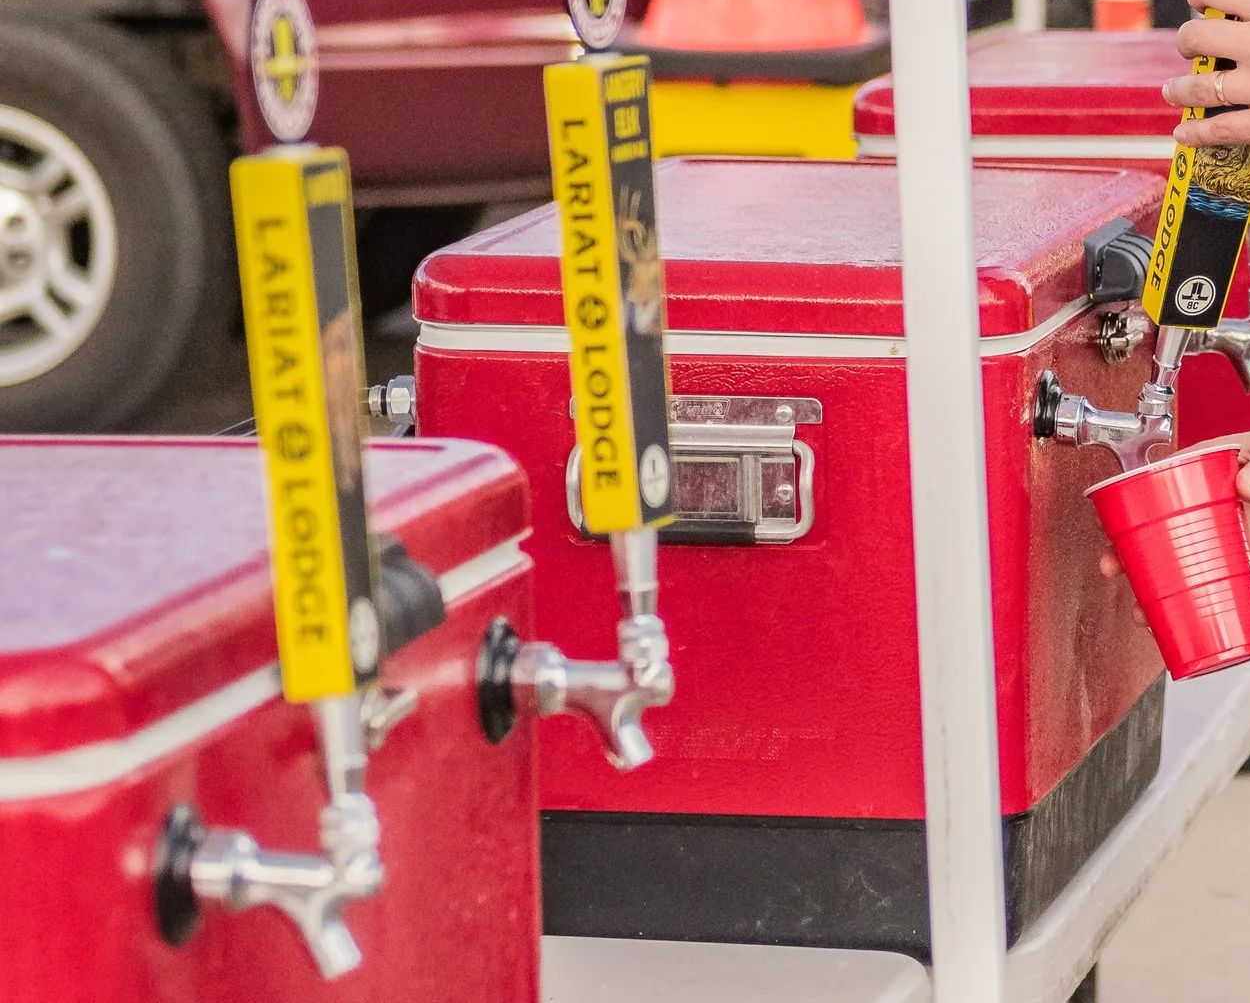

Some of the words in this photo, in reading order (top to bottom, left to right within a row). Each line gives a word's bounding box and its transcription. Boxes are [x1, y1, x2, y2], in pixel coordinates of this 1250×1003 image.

[561, 117, 601, 283] LARIAT
[582, 345, 622, 490] LODGE
[1149, 183, 1181, 293] LODGE
[255, 217, 306, 410] LARIAT
[281, 477, 329, 645] LODGE
